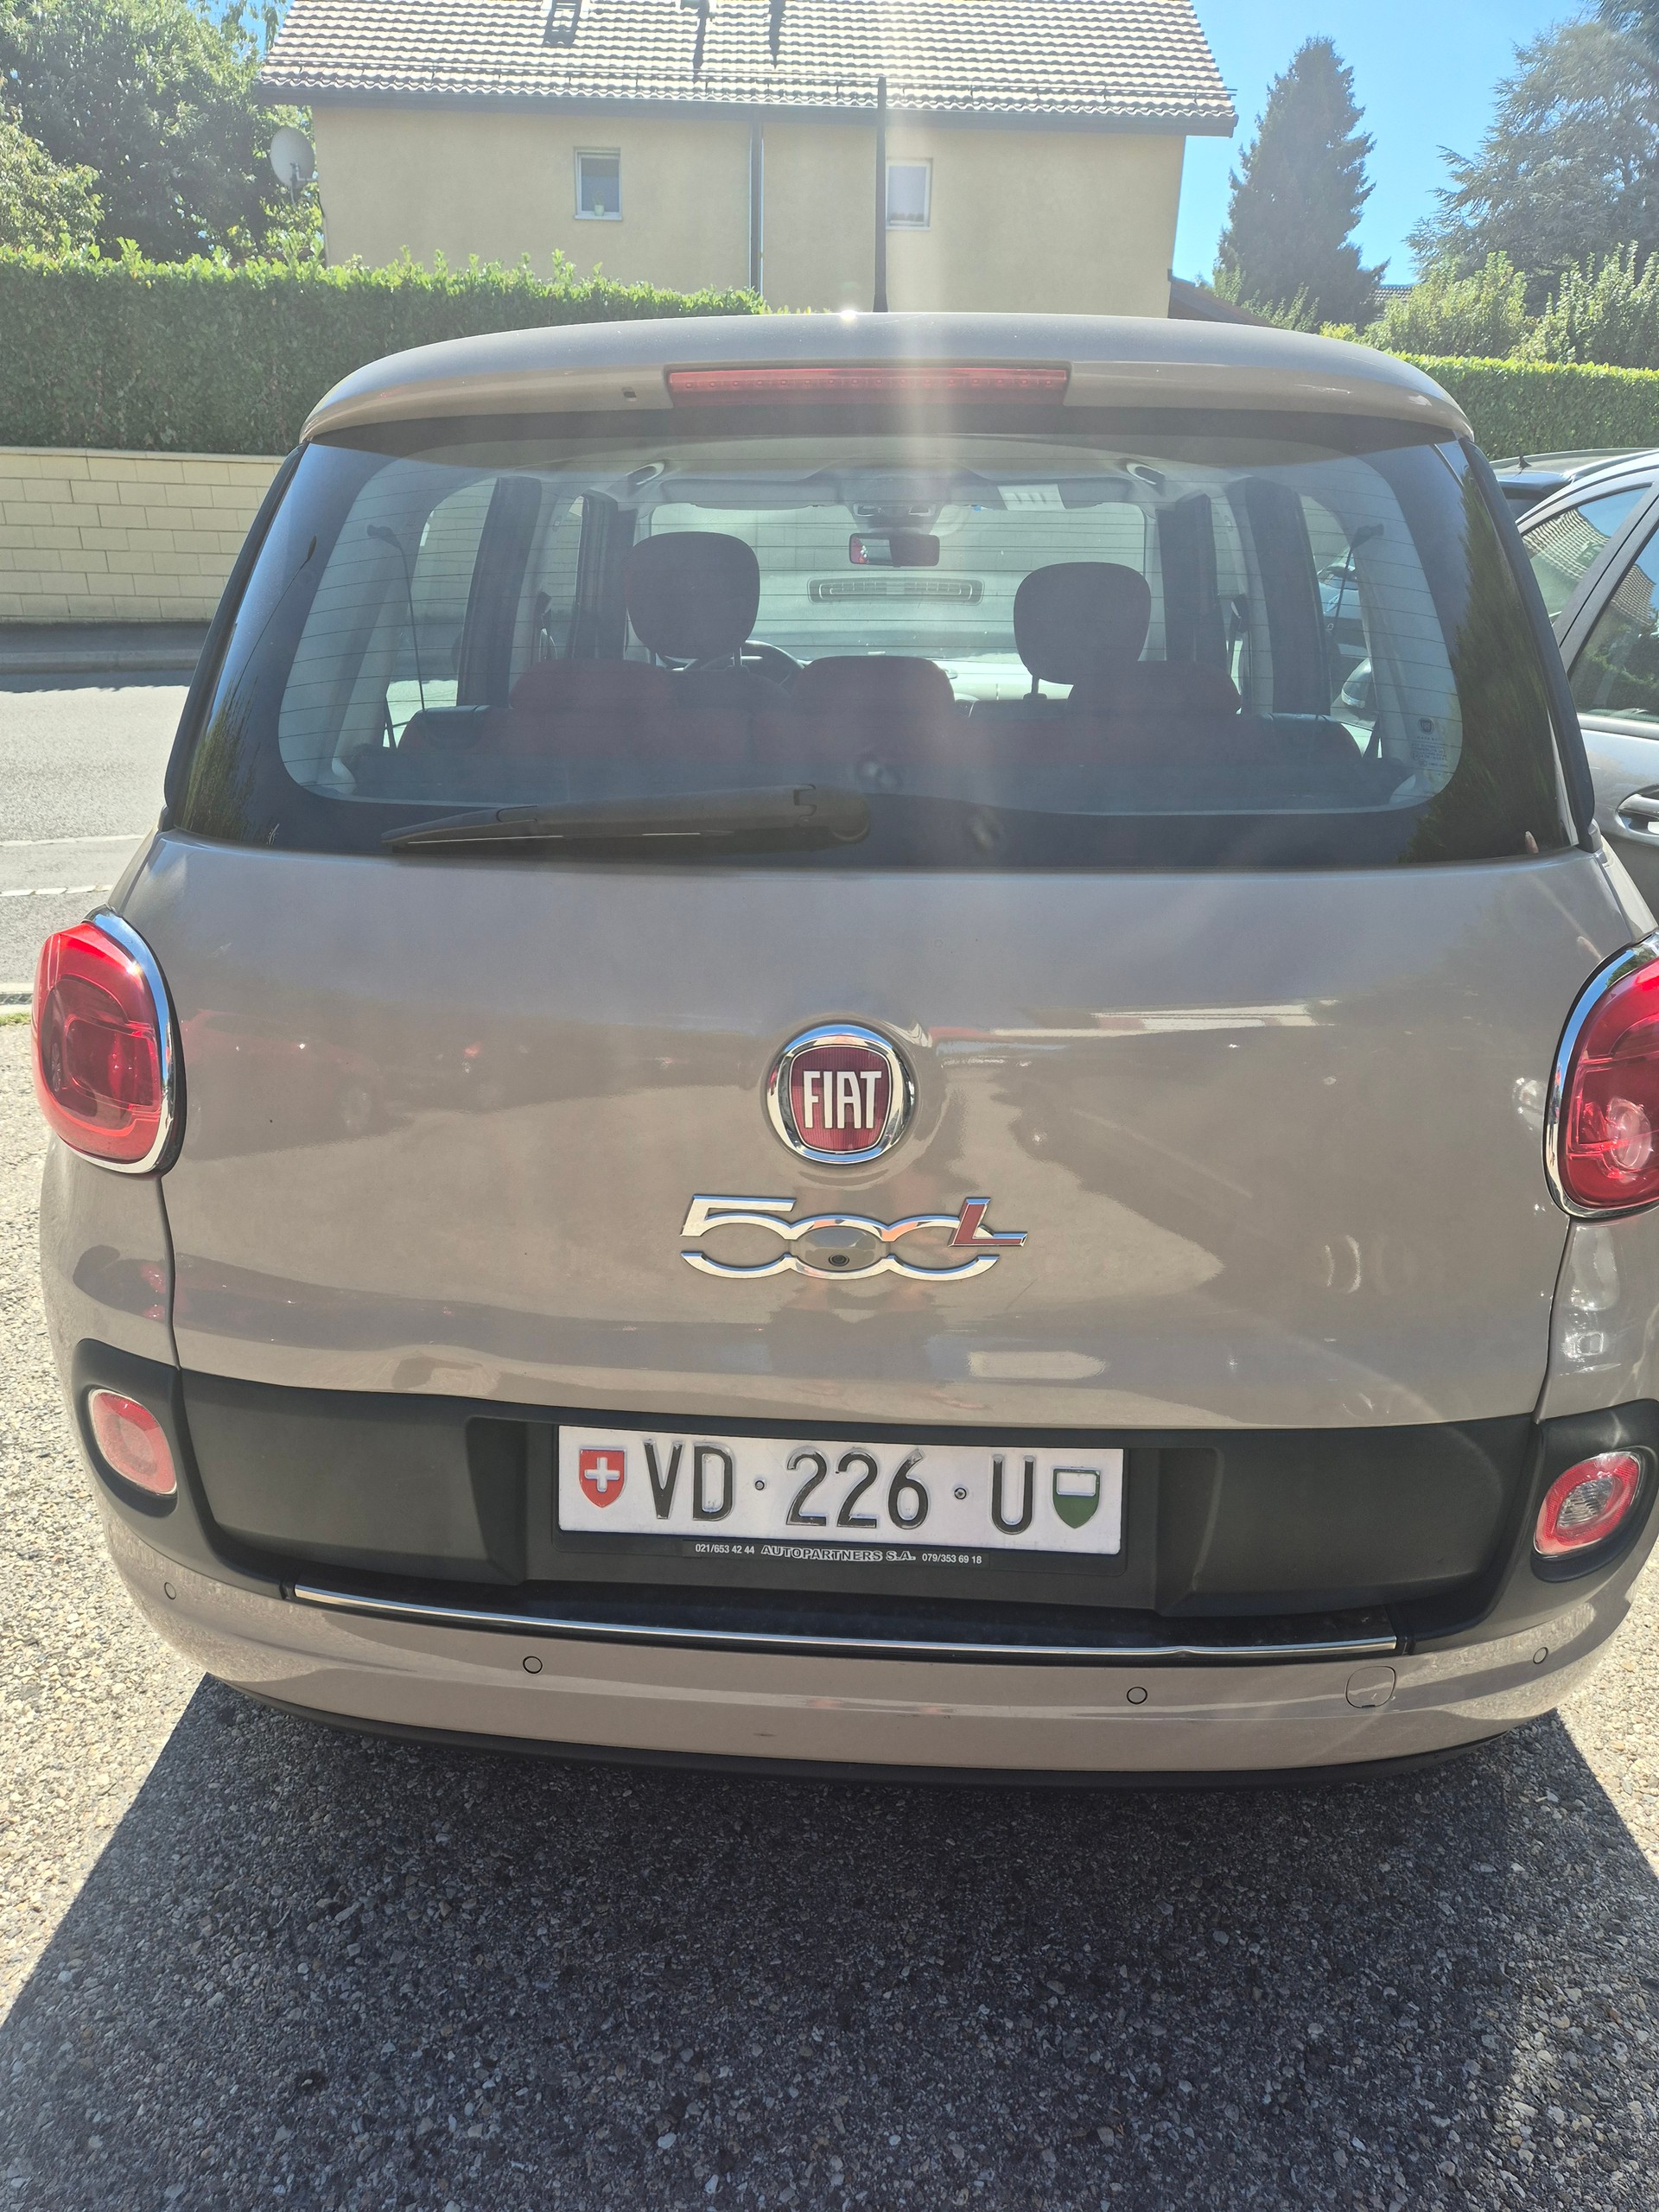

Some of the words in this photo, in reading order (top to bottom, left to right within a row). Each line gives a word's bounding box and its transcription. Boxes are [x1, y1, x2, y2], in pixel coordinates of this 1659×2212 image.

[803, 1071, 881, 1128] FIAT
[680, 1193, 1028, 1281] 500L
[642, 1438, 734, 1521] VD
[785, 1445, 928, 1530] 226
[989, 1453, 1035, 1535] U
[695, 1543, 730, 1554] 021/653
[732, 1545, 742, 1554] 42
[744, 1545, 755, 1554] 44
[760, 1544, 883, 1561] AUTOPARTNERS
[885, 1550, 917, 1561] S.A.
[921, 1553, 957, 1563] 079/353
[958, 1554, 969, 1564] 69
[971, 1555, 982, 1565] 18
